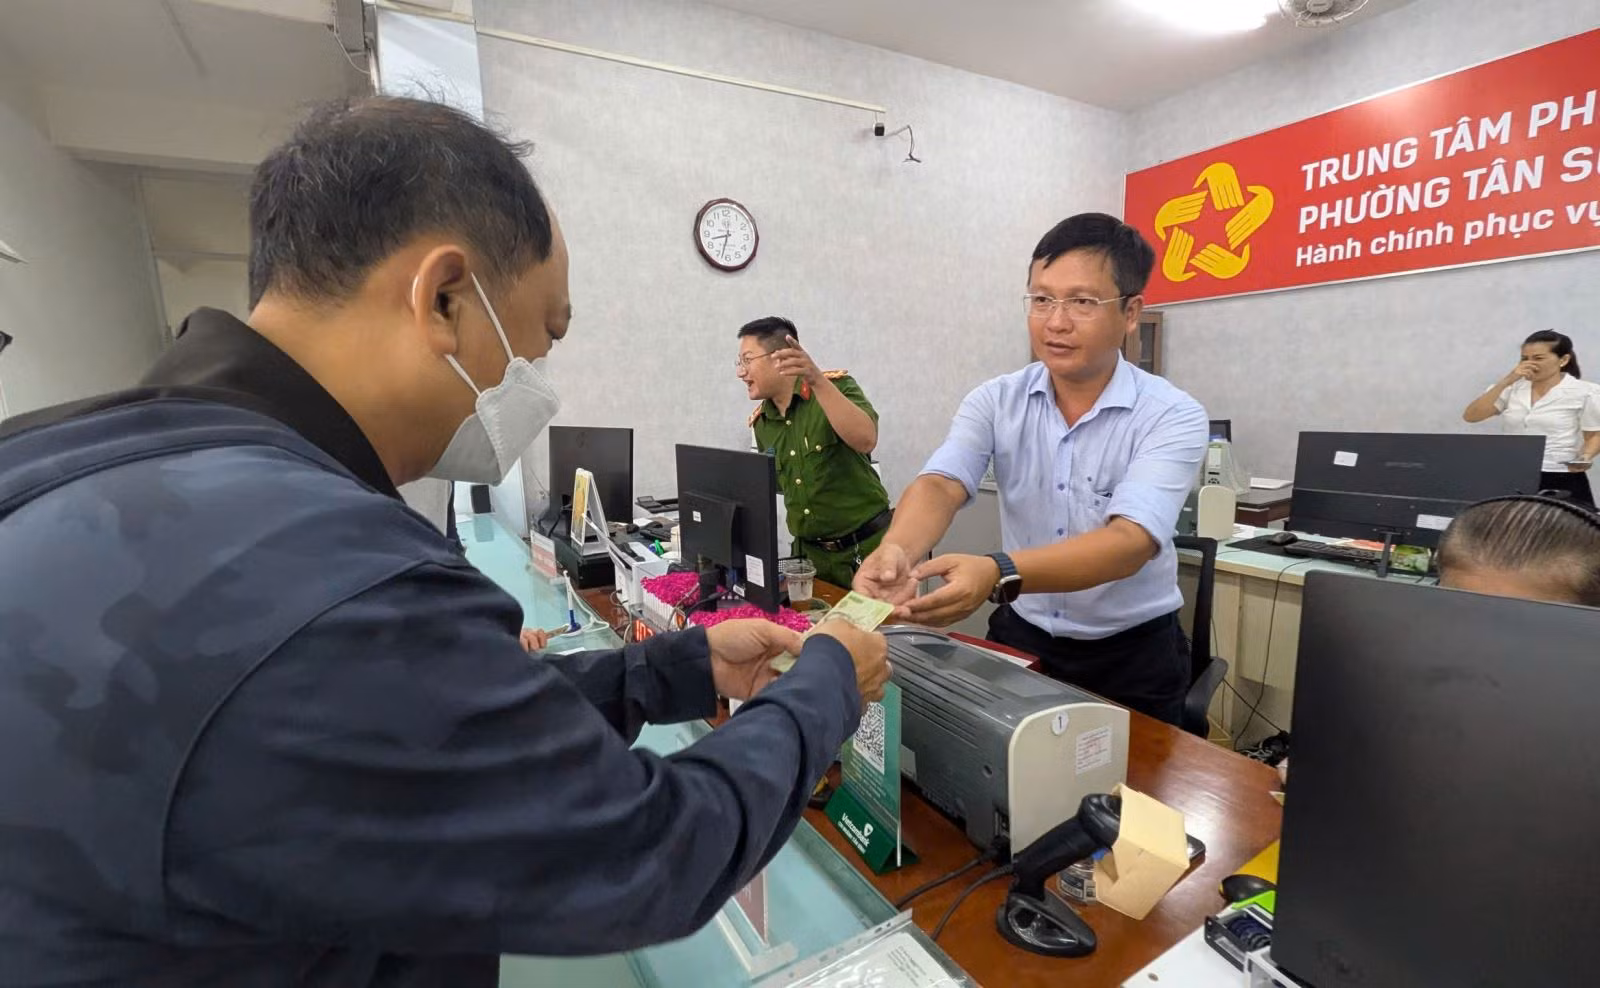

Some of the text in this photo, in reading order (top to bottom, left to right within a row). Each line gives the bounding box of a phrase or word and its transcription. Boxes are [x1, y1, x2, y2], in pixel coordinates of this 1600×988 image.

[1301, 136, 1419, 191] TRUNG
[1429, 111, 1513, 160] TÂM
[1298, 146, 1600, 234] PHƯỜNG TÂN S
[721, 209, 731, 217] 12
[706, 219, 715, 228] 10
[740, 222, 747, 231] 2
[703, 230, 711, 238] 9
[742, 233, 749, 241] 3
[1296, 237, 1362, 267] Hành
[1370, 221, 1454, 255] chính
[1463, 208, 1555, 246] phục
[707, 241, 714, 249] 8
[740, 244, 747, 252] 4
[715, 249, 721, 258] 7
[734, 251, 741, 259] 5
[724, 254, 731, 262] 6
[841, 812, 870, 848] Vietcombank
